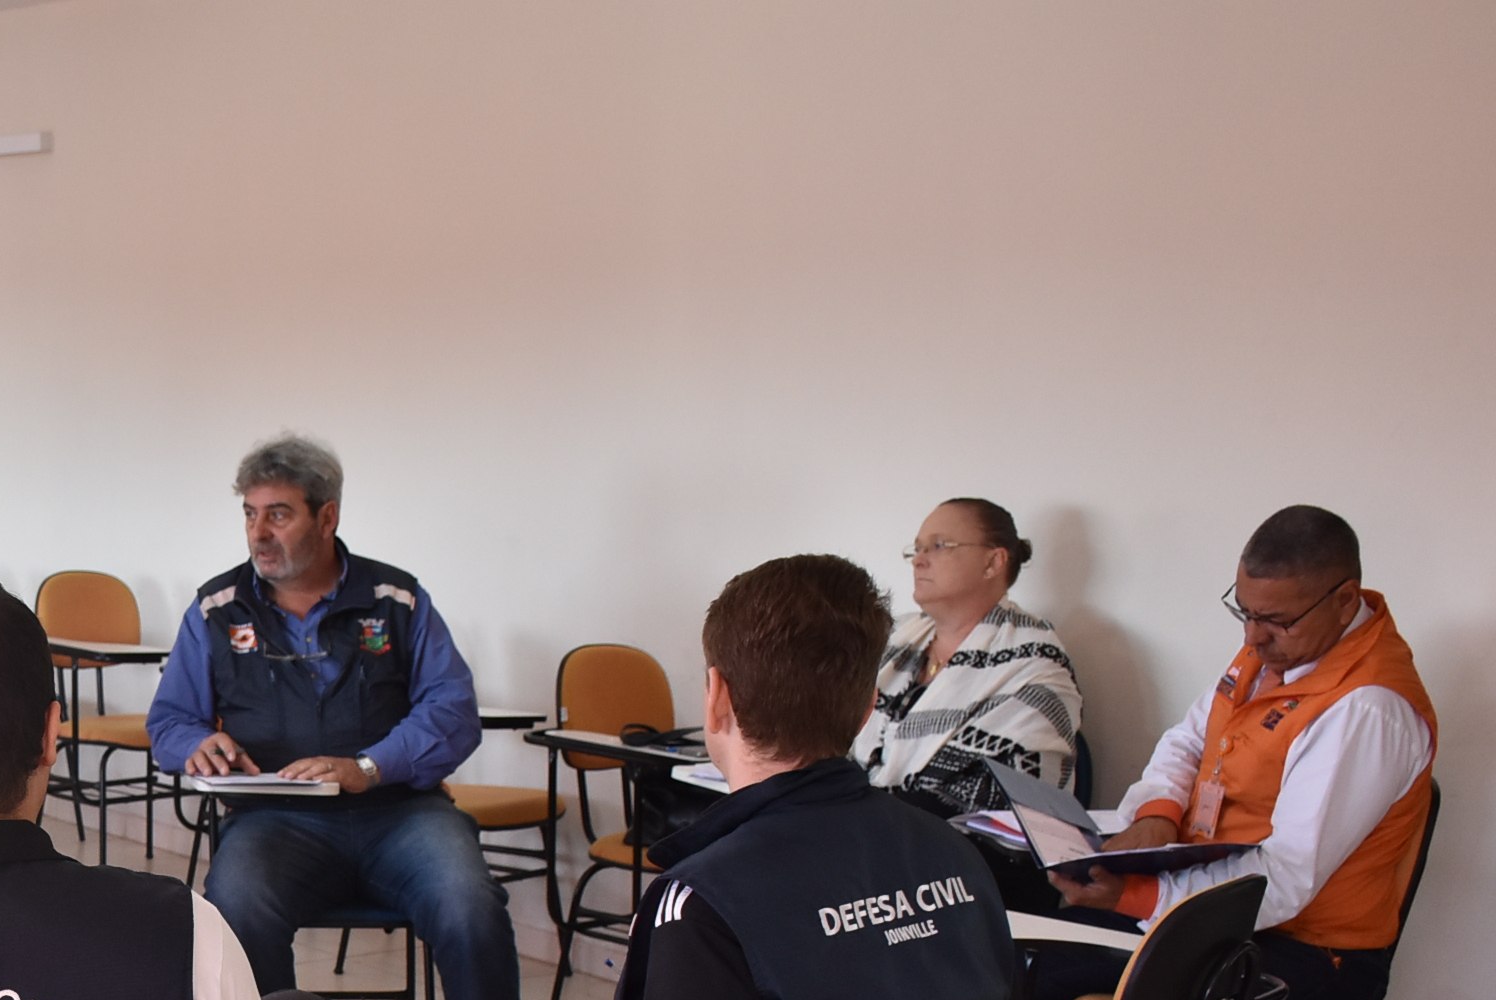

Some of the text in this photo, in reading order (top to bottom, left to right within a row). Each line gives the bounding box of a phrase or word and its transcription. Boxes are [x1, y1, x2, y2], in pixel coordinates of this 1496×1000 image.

[817, 876, 975, 937] DEFESA CIVIL
[883, 919, 939, 946] JOINVILLE
